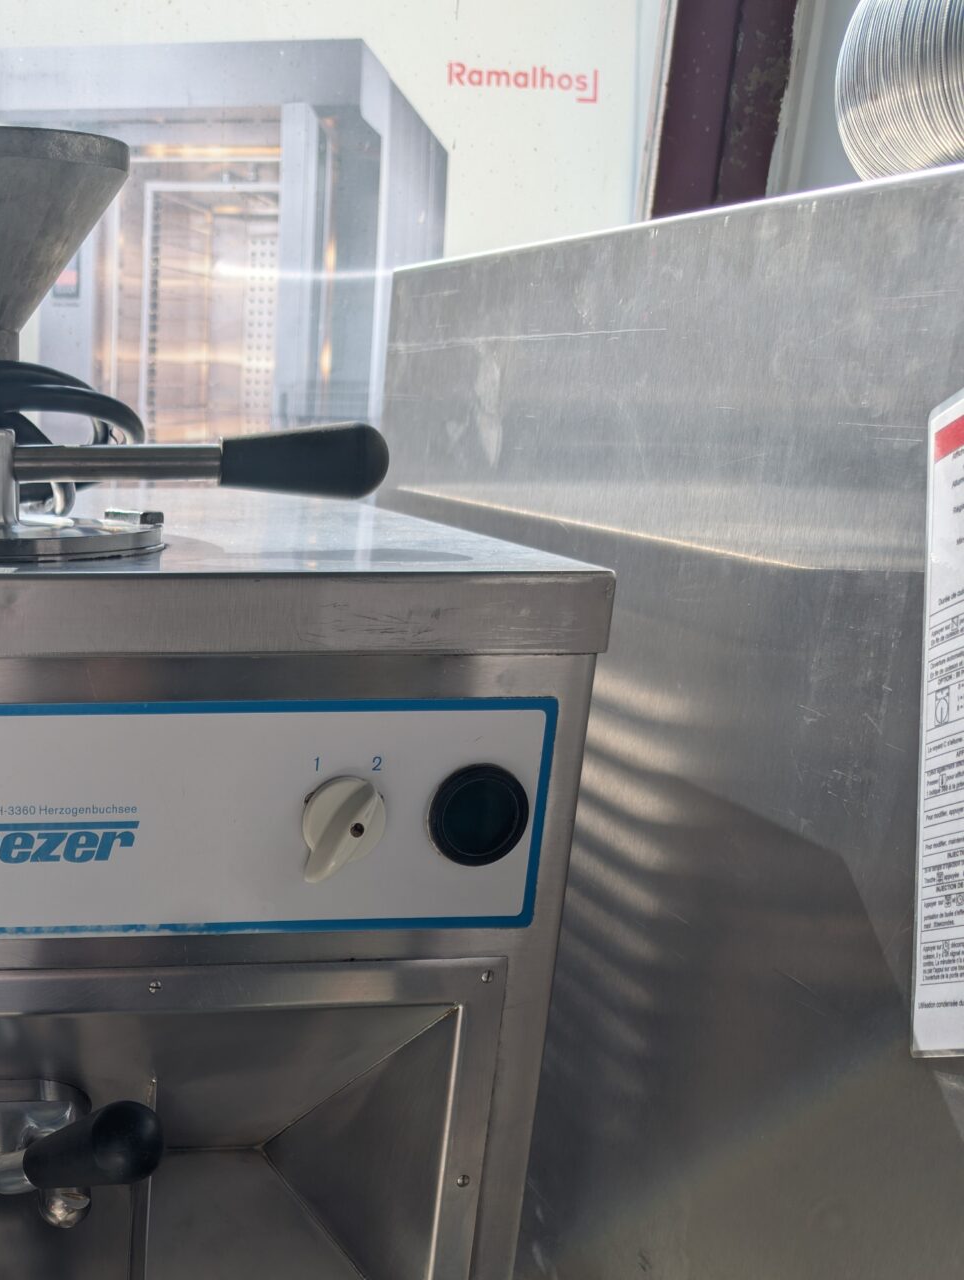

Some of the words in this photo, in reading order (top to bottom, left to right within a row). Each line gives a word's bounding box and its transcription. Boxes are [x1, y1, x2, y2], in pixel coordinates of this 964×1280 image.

[447, 61, 589, 92] Ramalhos
[314, 756, 321, 772] 1
[371, 756, 383, 772] 2
[39, 804, 137, 817] Herzogenbuchsee
